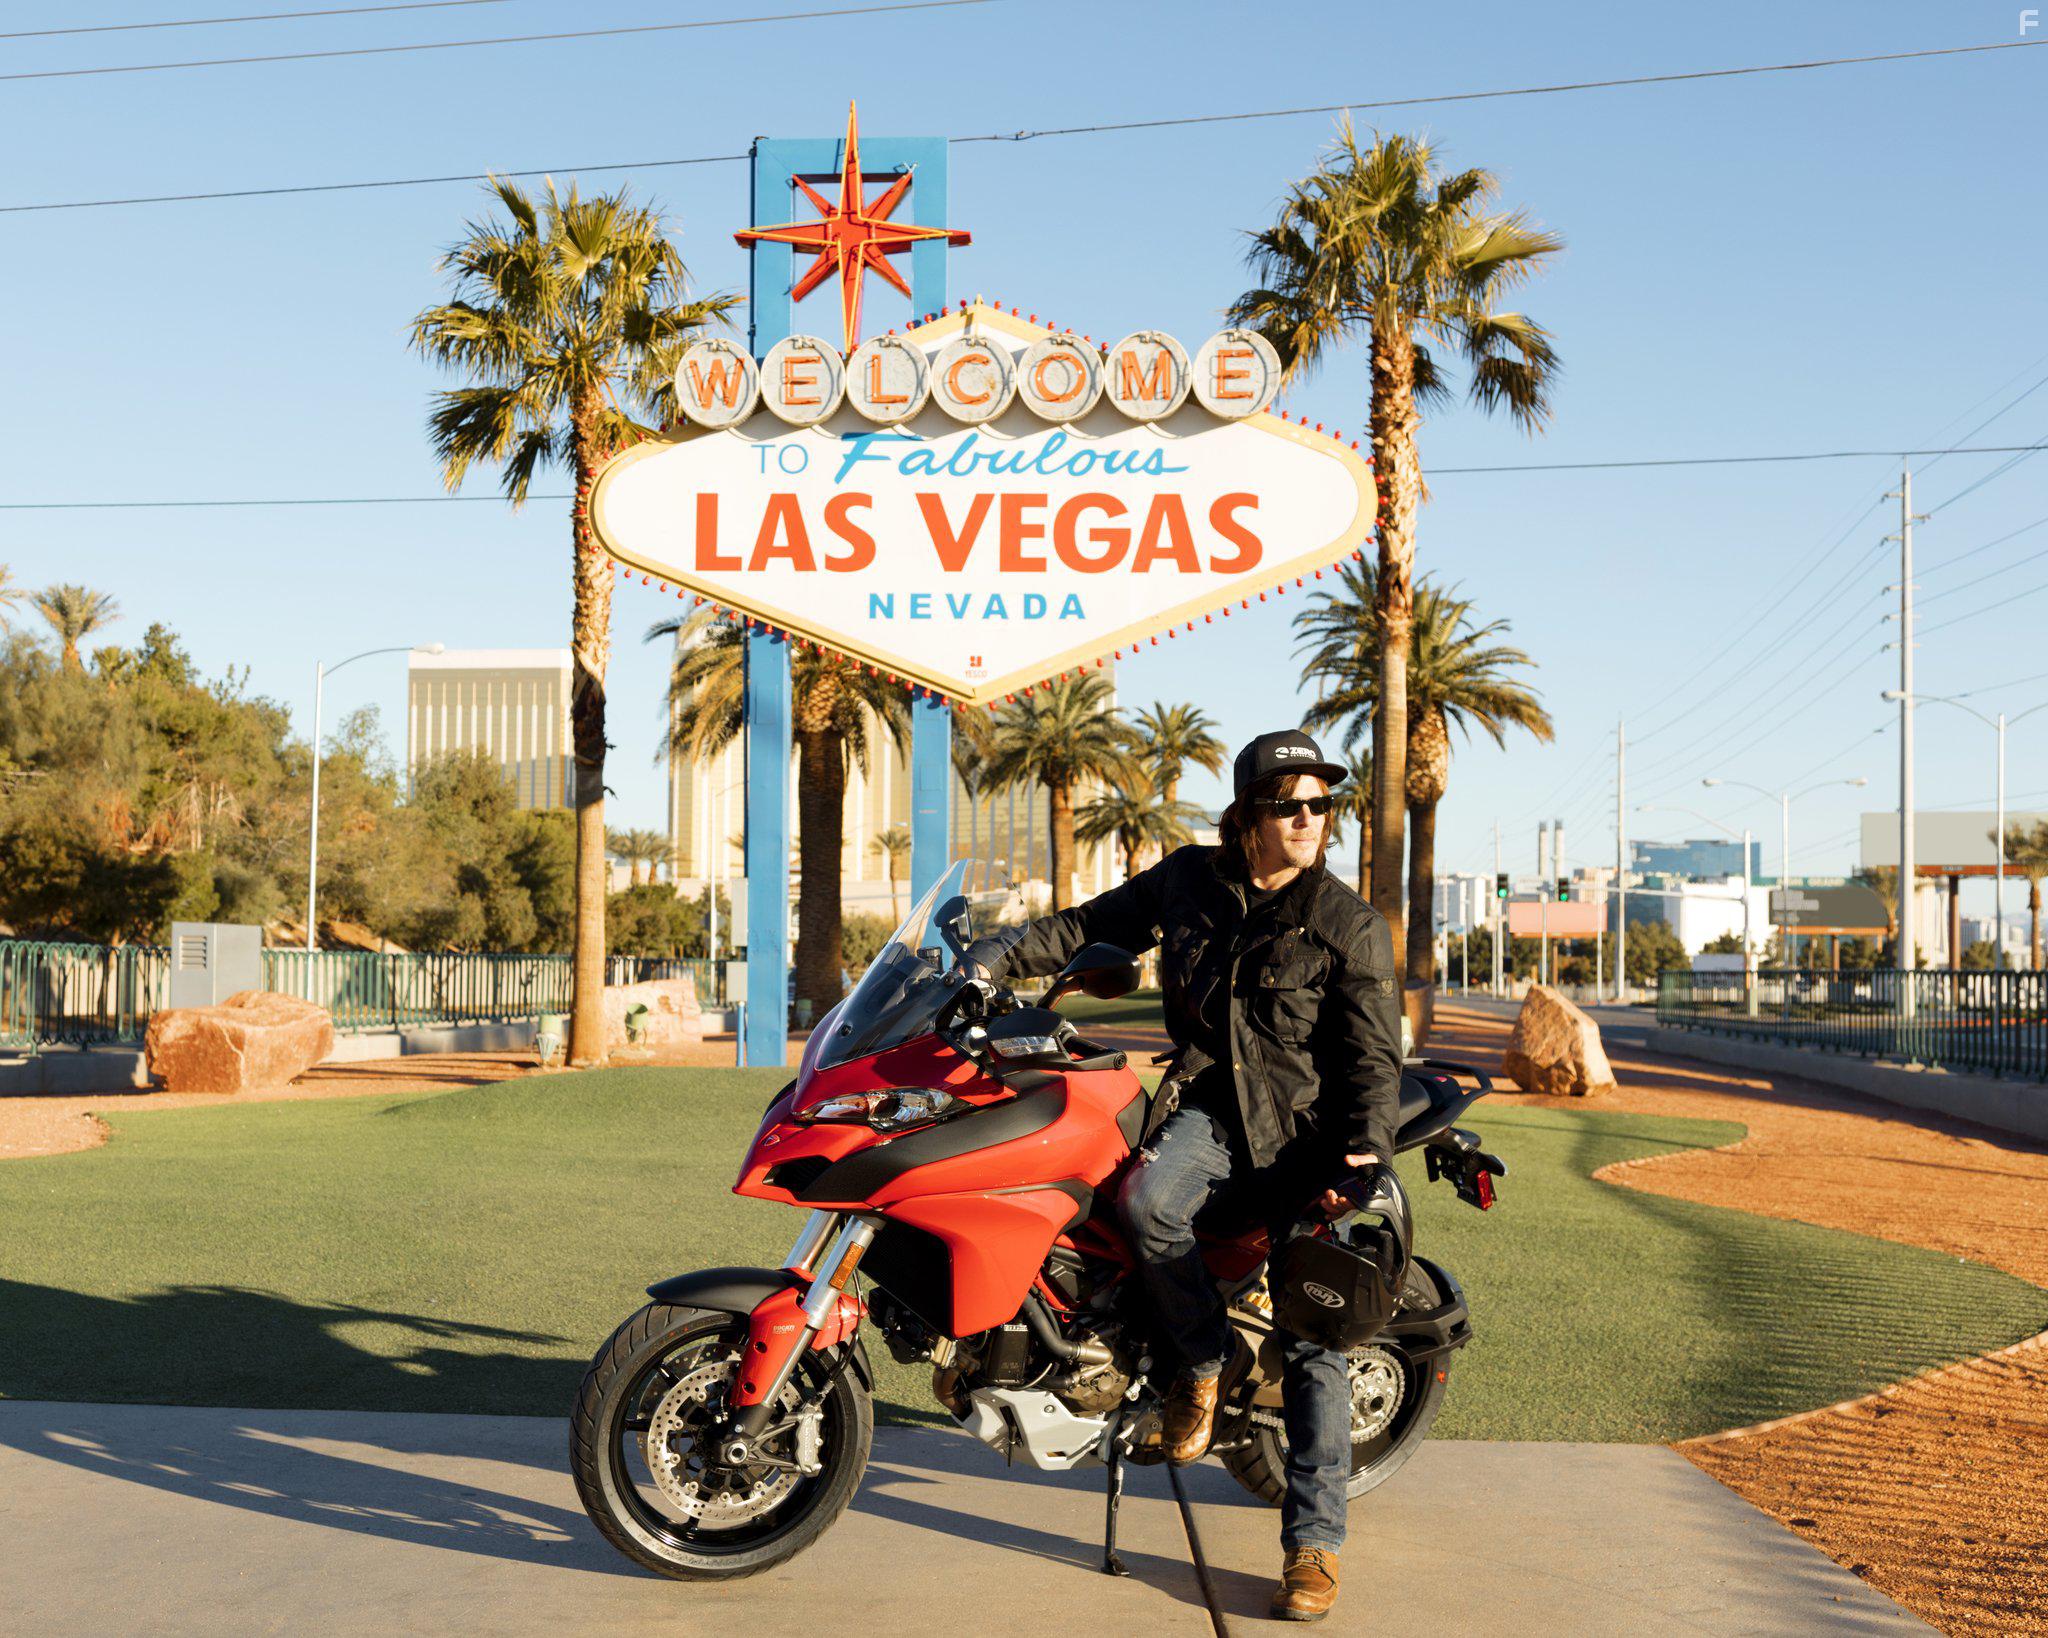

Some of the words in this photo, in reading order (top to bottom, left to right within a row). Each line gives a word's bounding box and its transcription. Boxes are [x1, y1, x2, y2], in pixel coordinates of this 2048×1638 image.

[689, 349, 1255, 410] WELCOME
[752, 443, 809, 475] TO
[833, 431, 1188, 485] Fabulous
[694, 491, 876, 573] LAS
[915, 492, 1263, 574] VEGAS
[868, 592, 1086, 621] NEVADA
